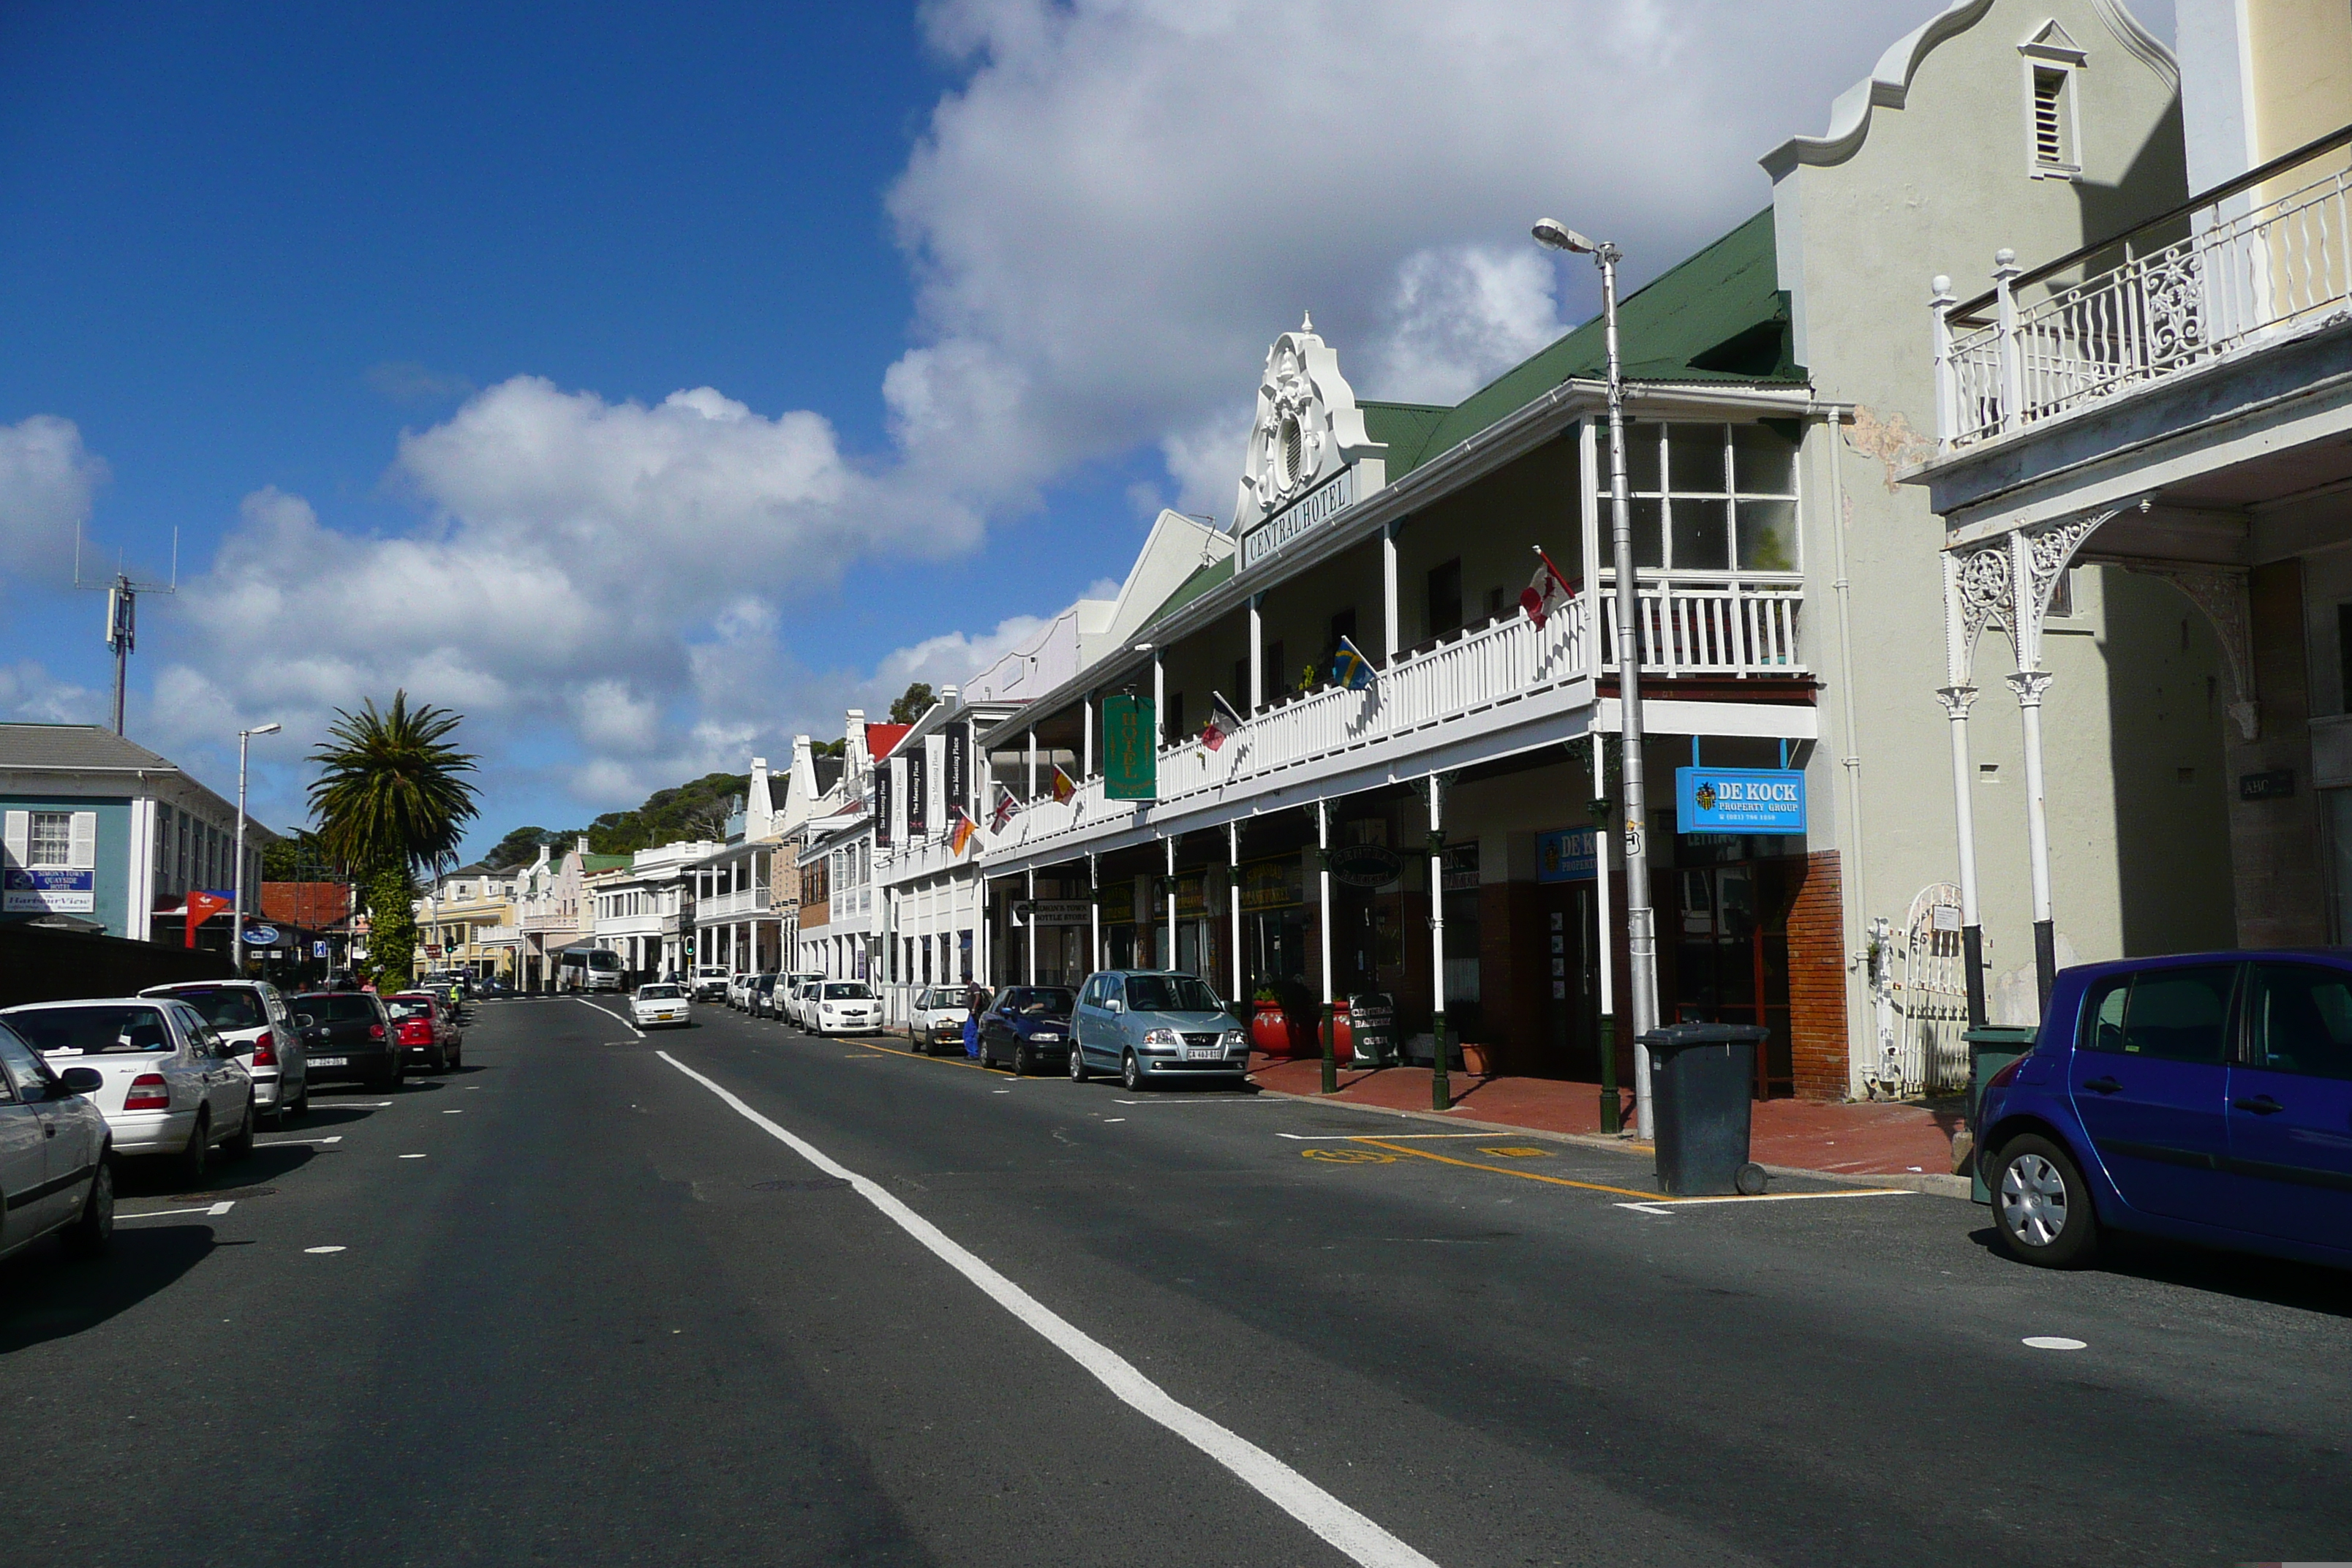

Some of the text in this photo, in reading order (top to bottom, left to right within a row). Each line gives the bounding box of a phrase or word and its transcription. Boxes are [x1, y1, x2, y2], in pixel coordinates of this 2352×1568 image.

[1250, 480, 1346, 561] CENTRAL HOTEL
[1121, 712, 1139, 778] HOTEL
[1718, 783, 1798, 802] DE KOCK
[1719, 802, 1798, 812] PROPERTY GROUP
[1561, 834, 1581, 858] DE
[1351, 1006, 1393, 1017] CENTRAL
[1362, 1036, 1388, 1046] OPEN
